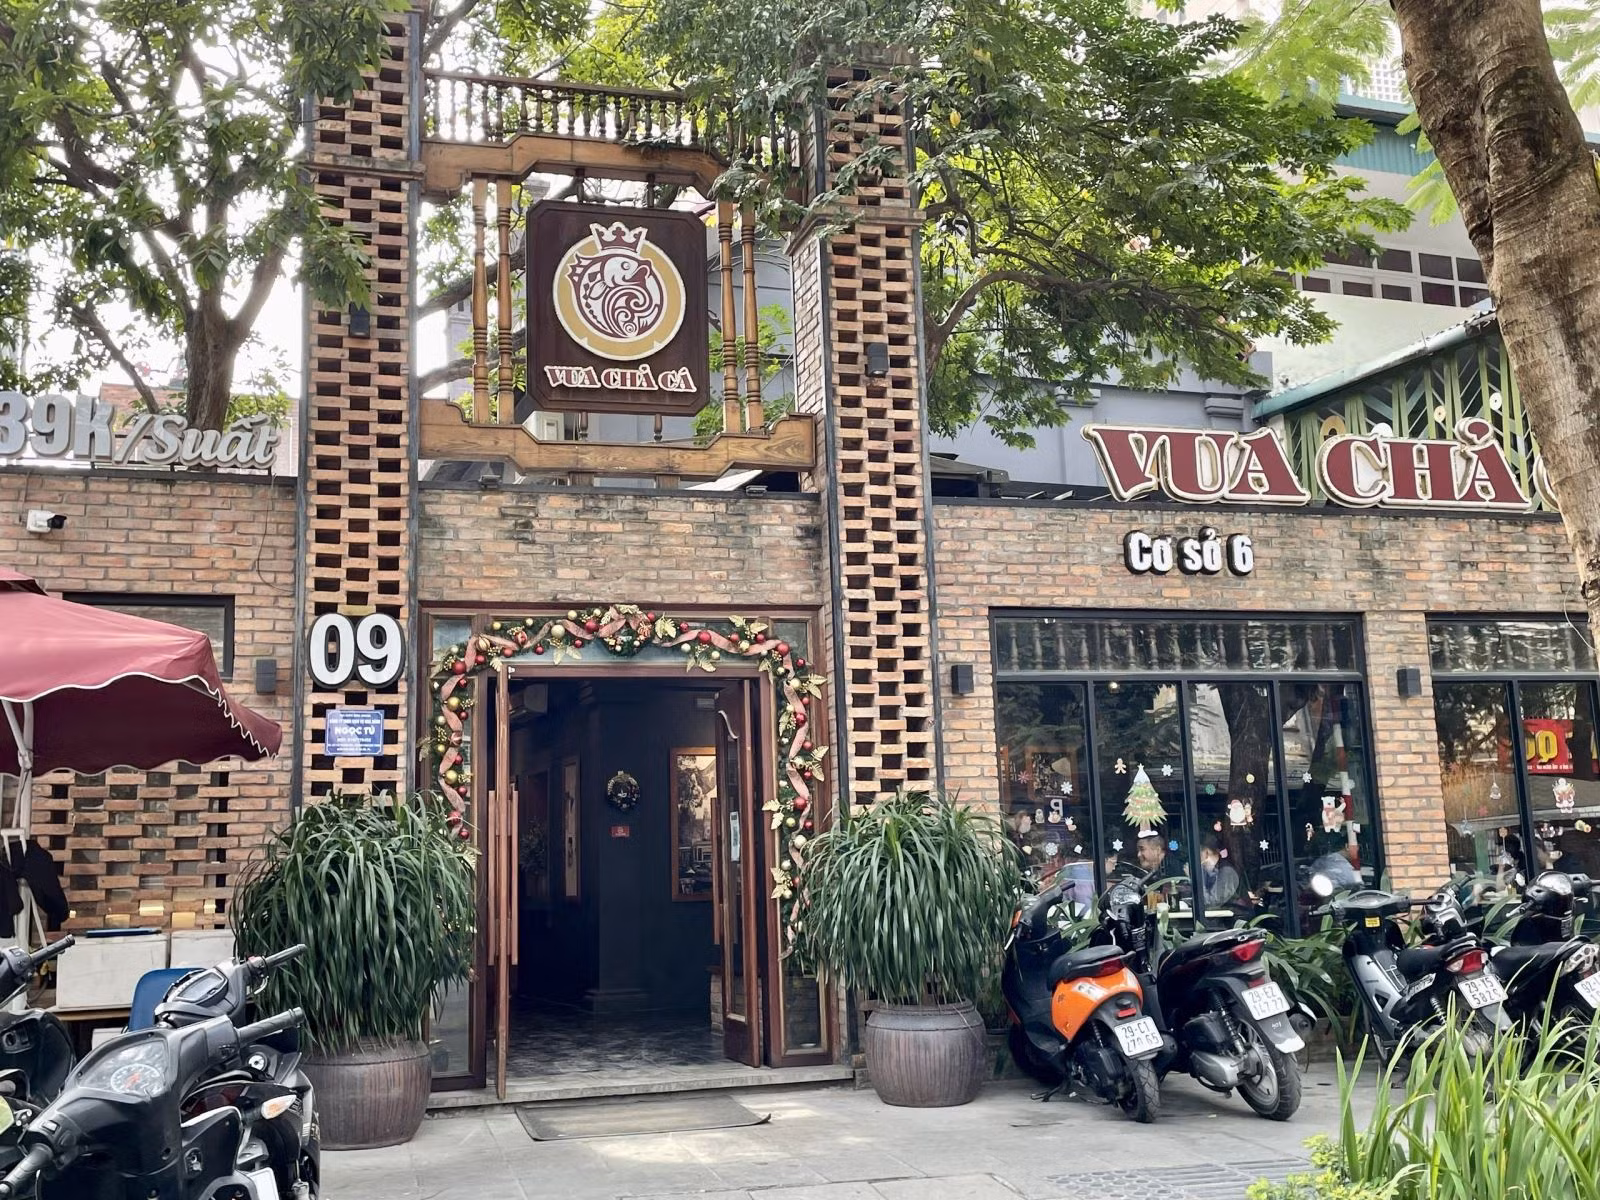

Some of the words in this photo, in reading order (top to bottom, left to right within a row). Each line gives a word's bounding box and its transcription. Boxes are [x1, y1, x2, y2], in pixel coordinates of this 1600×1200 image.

[544, 365, 601, 388] VUA
[601, 364, 658, 390] CHẢ
[1080, 425, 1312, 506] VUA
[1315, 417, 1533, 513] CHẢ
[1125, 531, 1173, 574] Cơ
[1227, 533, 1254, 576] 6
[308, 613, 405, 688] 09
[1122, 1021, 1150, 1039] 29-C1
